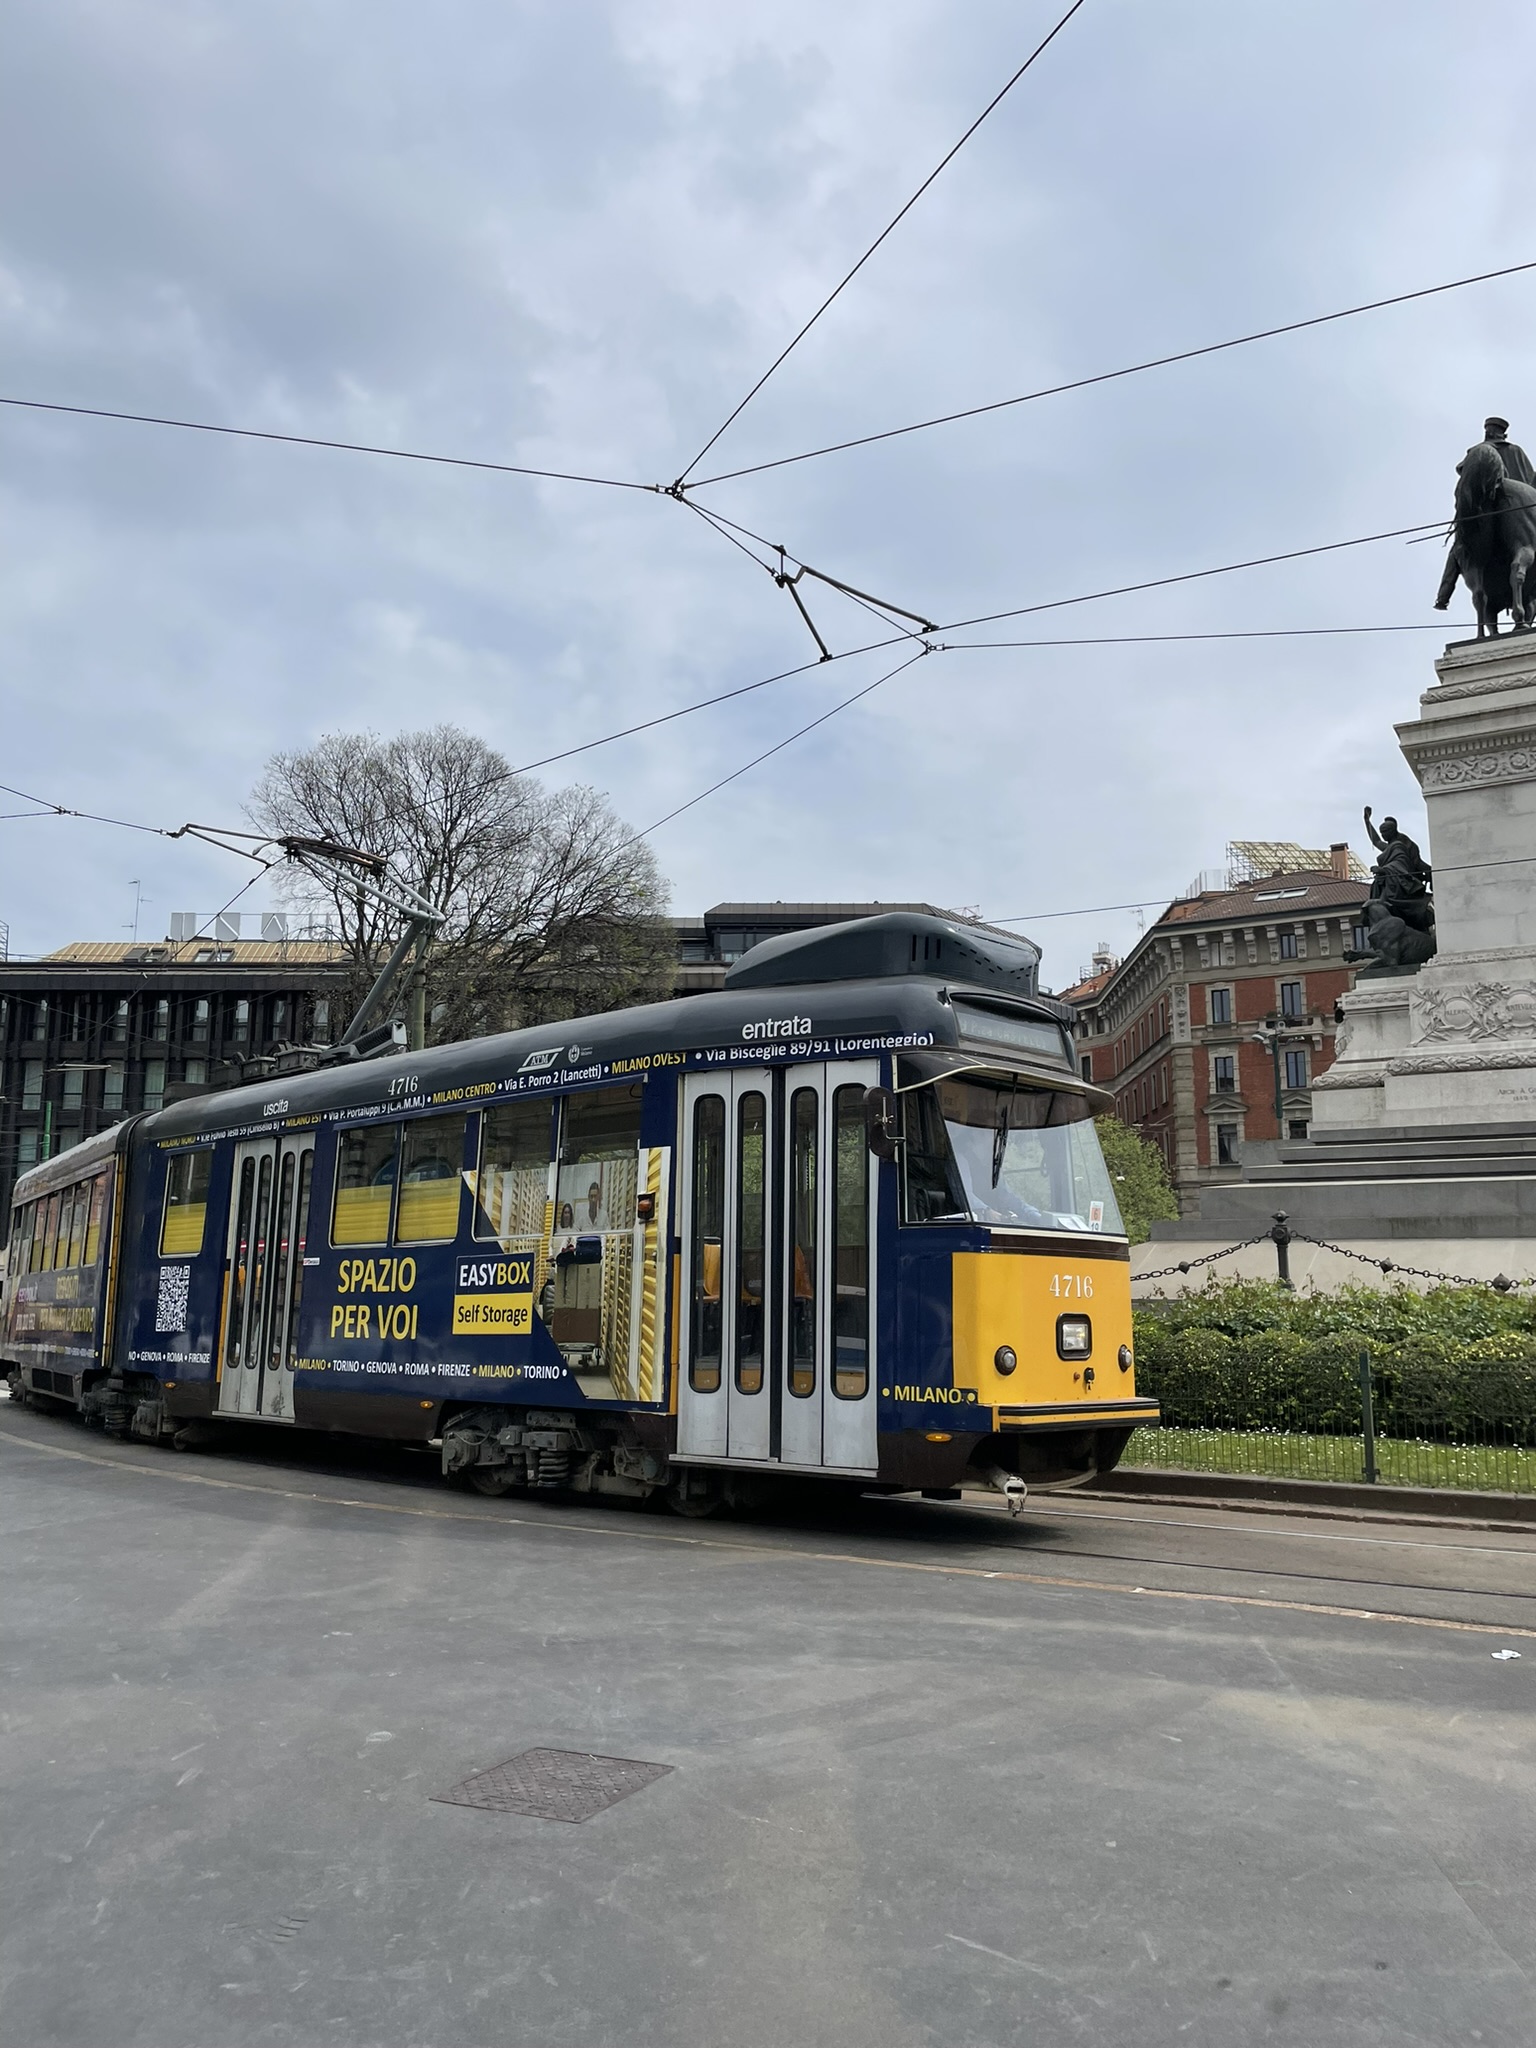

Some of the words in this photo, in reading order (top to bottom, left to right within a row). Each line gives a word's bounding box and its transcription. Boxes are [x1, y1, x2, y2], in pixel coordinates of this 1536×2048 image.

[742, 1015, 812, 1040] entrata
[530, 1054, 549, 1066] ATM
[286, 1116, 311, 1128] MILANO
[311, 1114, 322, 1125] EST
[328, 1109, 340, 1121] Via
[433, 1088, 464, 1105] MILANO
[464, 1081, 497, 1098] CENTRO
[504, 1079, 518, 1091] Via
[518, 1077, 528, 1088] E.
[529, 1074, 551, 1087] Porro
[553, 1072, 559, 1084] 2
[560, 1063, 602, 1085] (Lancetti)
[612, 1056, 651, 1075] MILANO
[652, 1051, 687, 1068] OVEST
[705, 1049, 726, 1062] Via
[730, 1044, 787, 1062] Bisceglie
[789, 1039, 832, 1057] 89/91
[835, 1032, 937, 1055] (Lorenteggio)
[387, 1075, 419, 1096] 4716
[263, 1098, 289, 1117] uscita
[337, 1256, 417, 1294] SPAZIO
[459, 1260, 531, 1288] EASYBOX
[1049, 1274, 1094, 1298] 4716
[330, 1304, 371, 1339] PER
[377, 1303, 418, 1341] VOI
[457, 1304, 480, 1323] Self
[481, 1305, 528, 1328] Storage
[140, 1351, 162, 1361] GENOVA
[166, 1352, 183, 1362] ROMA
[188, 1353, 210, 1364] FIRENZE
[299, 1359, 327, 1371] MILANO
[333, 1360, 359, 1372] TORINO
[366, 1361, 397, 1374] GENOVA
[404, 1363, 430, 1376] ROMA
[437, 1364, 471, 1377] FIRENZE
[478, 1364, 514, 1379] MILANO
[524, 1365, 560, 1380] TORINO
[894, 1384, 962, 1404] MILANO
